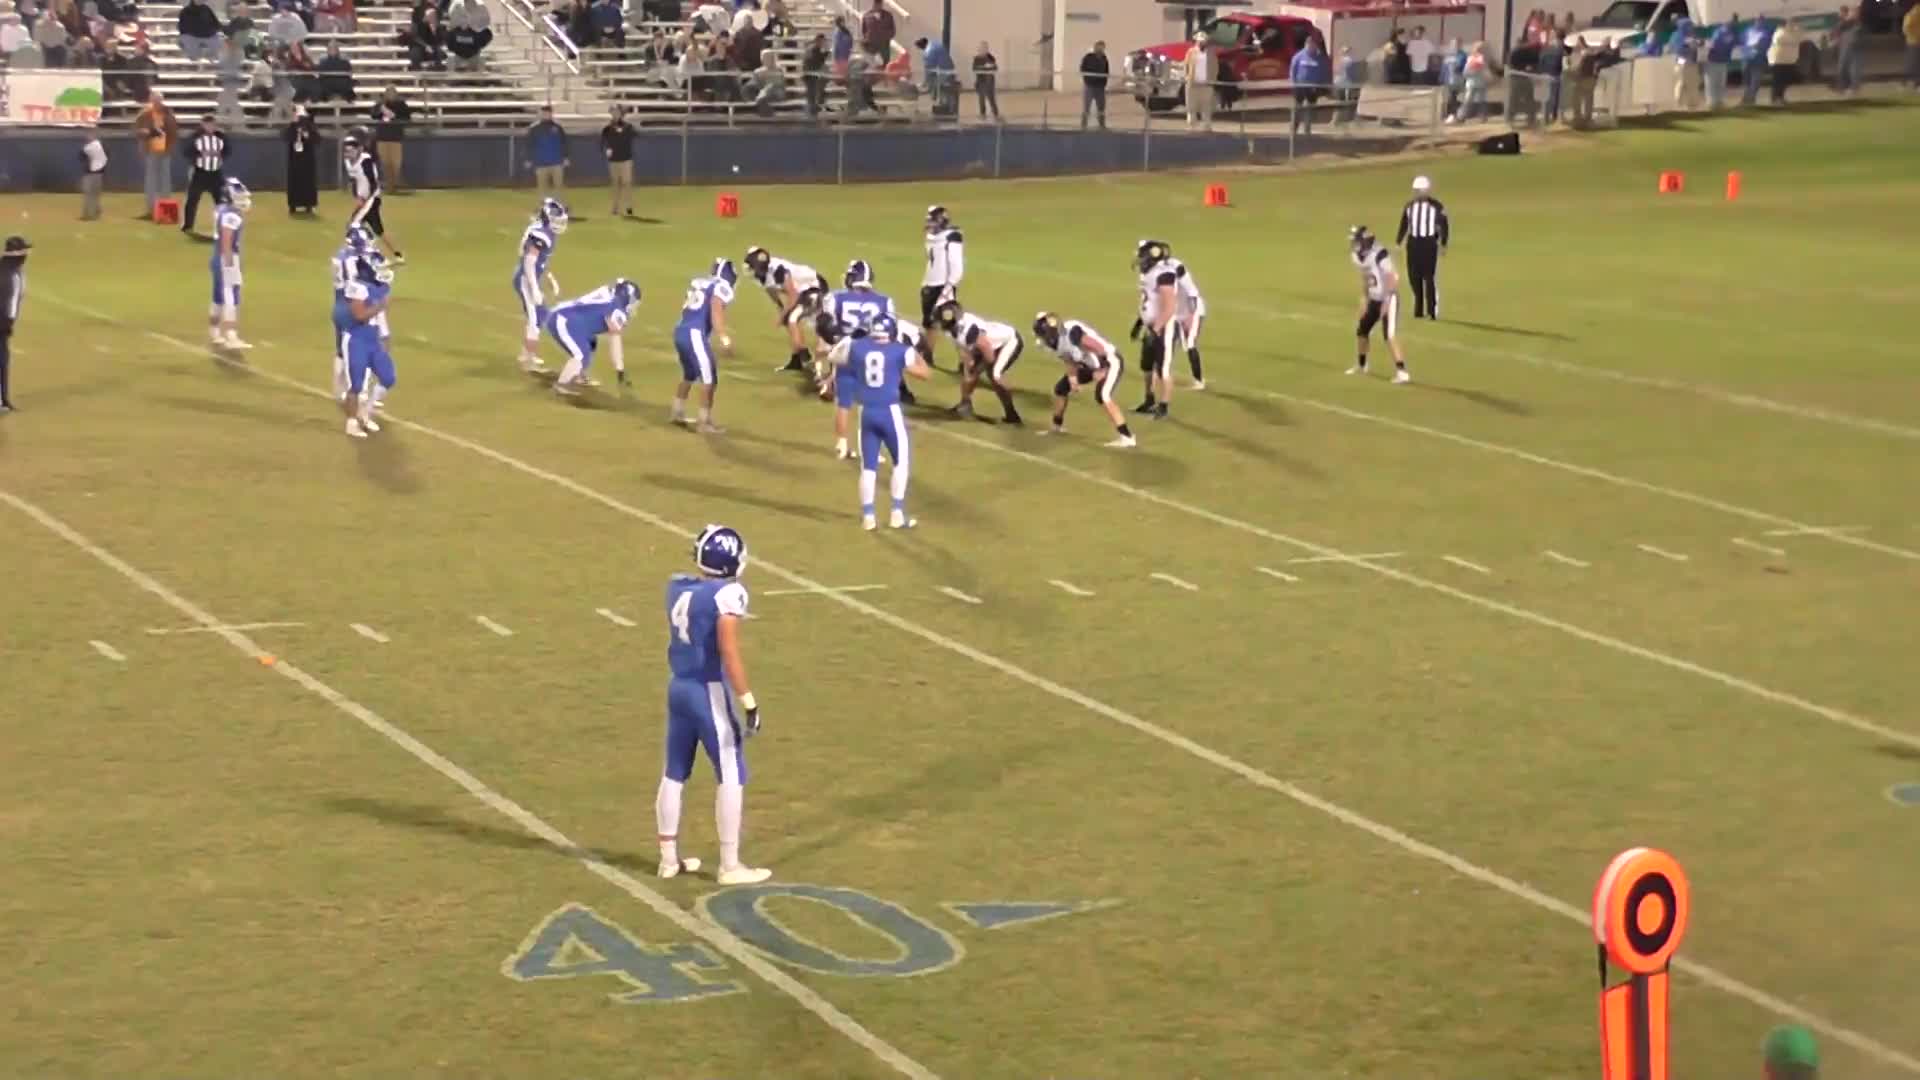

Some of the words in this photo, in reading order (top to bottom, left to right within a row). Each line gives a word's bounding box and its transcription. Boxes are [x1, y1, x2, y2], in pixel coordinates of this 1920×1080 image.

[864, 350, 886, 389] 8
[671, 590, 694, 645] 4
[501, 883, 968, 1004] 40
